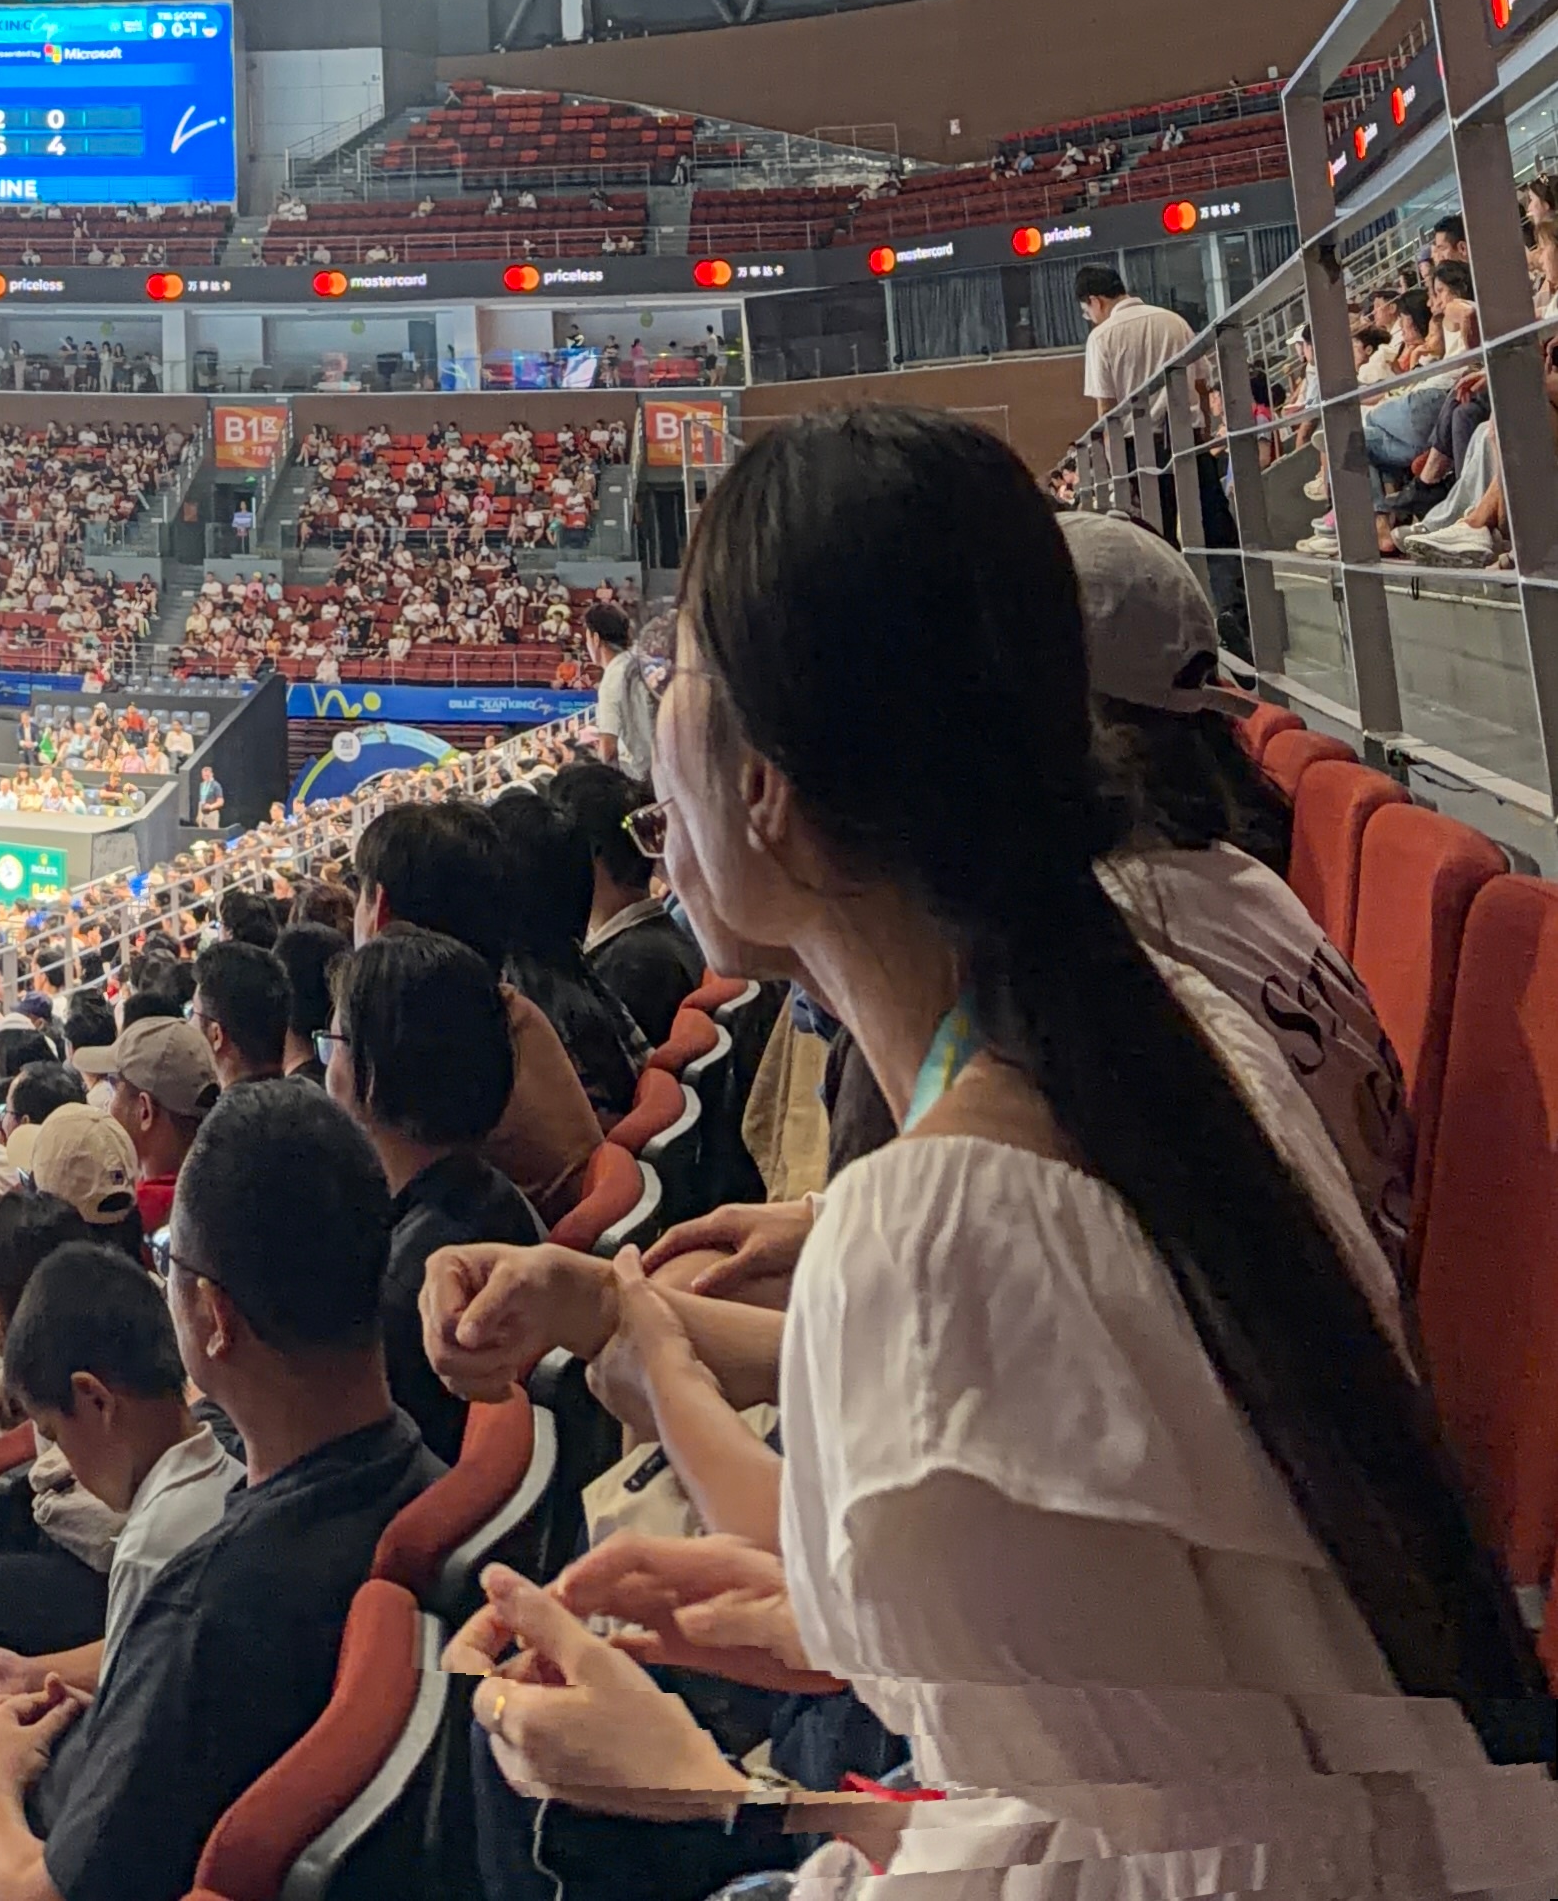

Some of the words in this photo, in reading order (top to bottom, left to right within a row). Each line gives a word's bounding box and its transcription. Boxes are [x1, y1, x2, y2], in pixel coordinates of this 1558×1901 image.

[171, 22, 197, 37] 0-1
[64, 47, 122, 61] Microsoft
[47, 109, 65, 129] 0
[47, 136, 66, 156] 4
[1043, 225, 1092, 246] priceless
[896, 241, 954, 262] mastercard
[8, 277, 64, 294] priceless
[349, 273, 427, 288] mastercard
[543, 268, 604, 286] priceless
[224, 416, 278, 443] B1区
